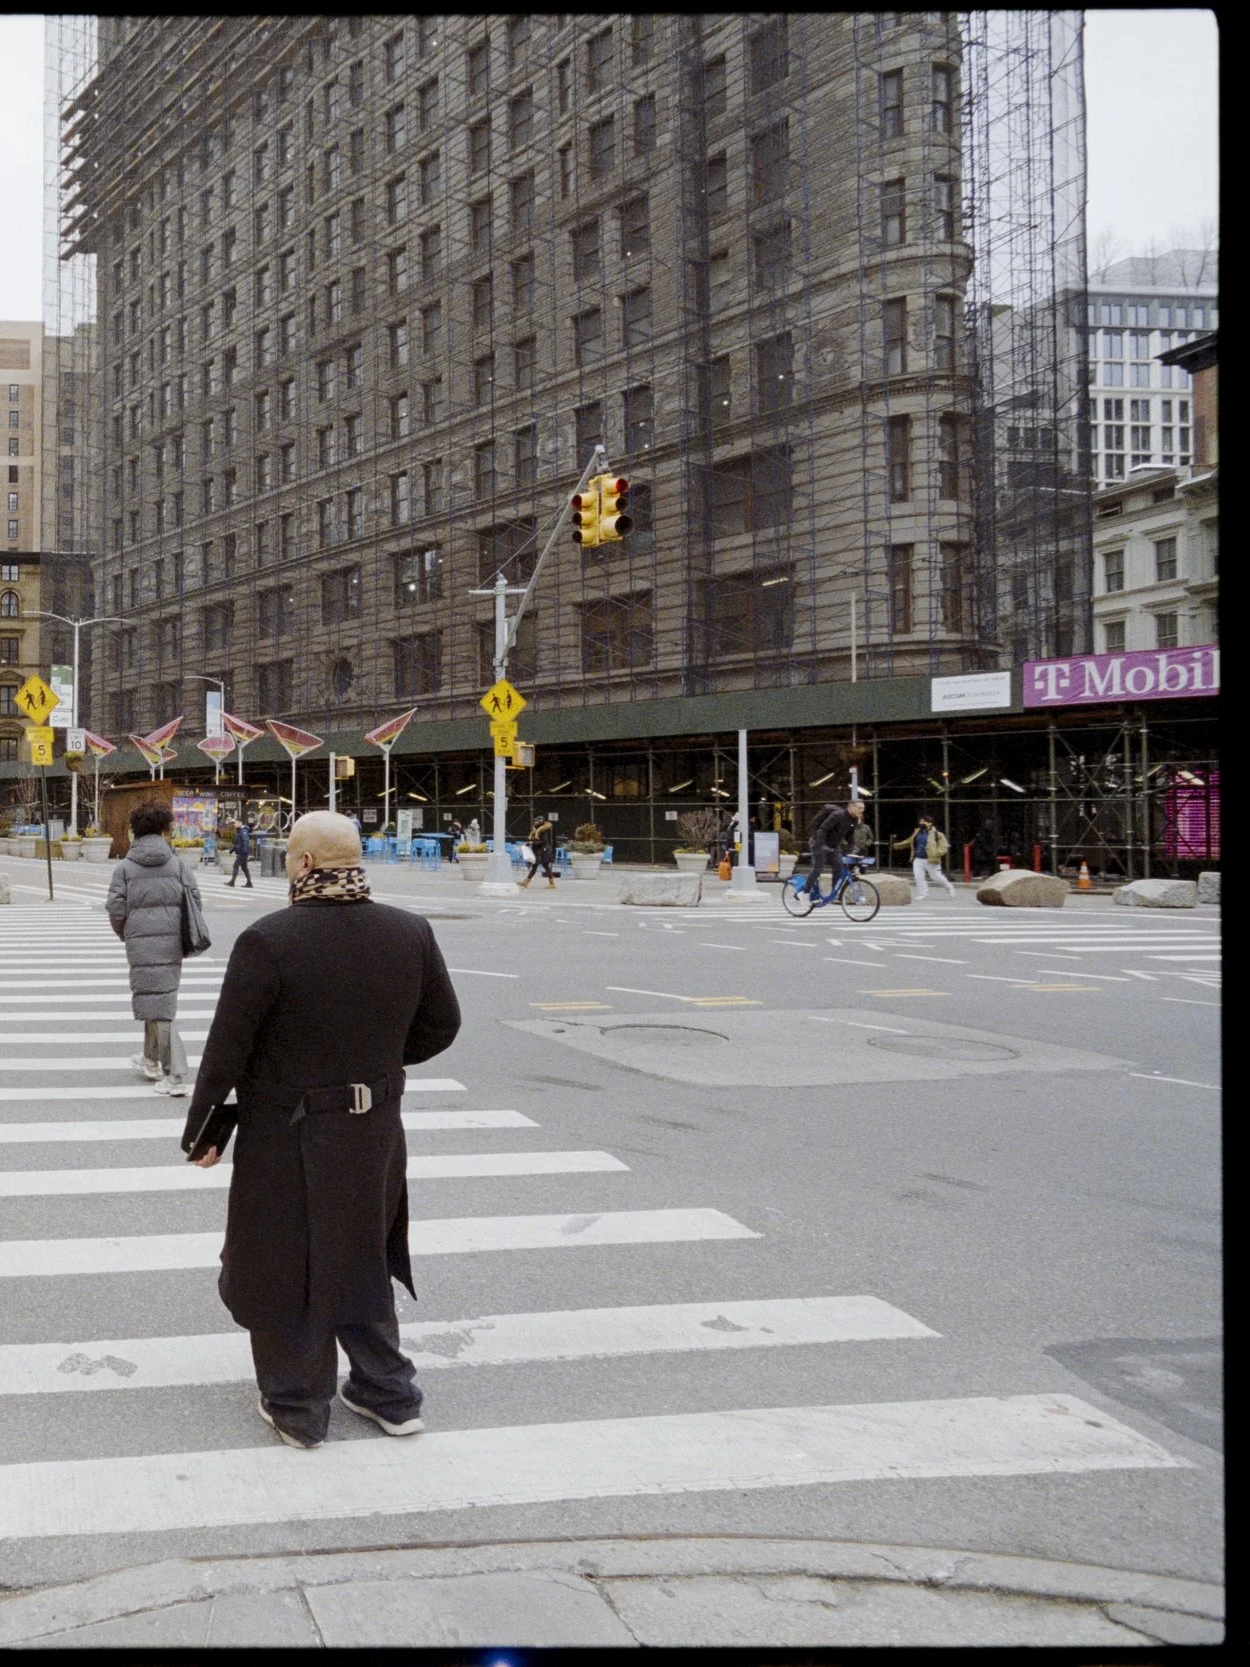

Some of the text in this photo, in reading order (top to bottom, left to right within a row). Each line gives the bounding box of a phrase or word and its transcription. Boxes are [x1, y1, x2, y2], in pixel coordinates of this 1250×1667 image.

[1034, 663, 1069, 701] T
[71, 740, 82, 750] 10
[500, 737, 508, 748] 5
[38, 744, 46, 756] 5
